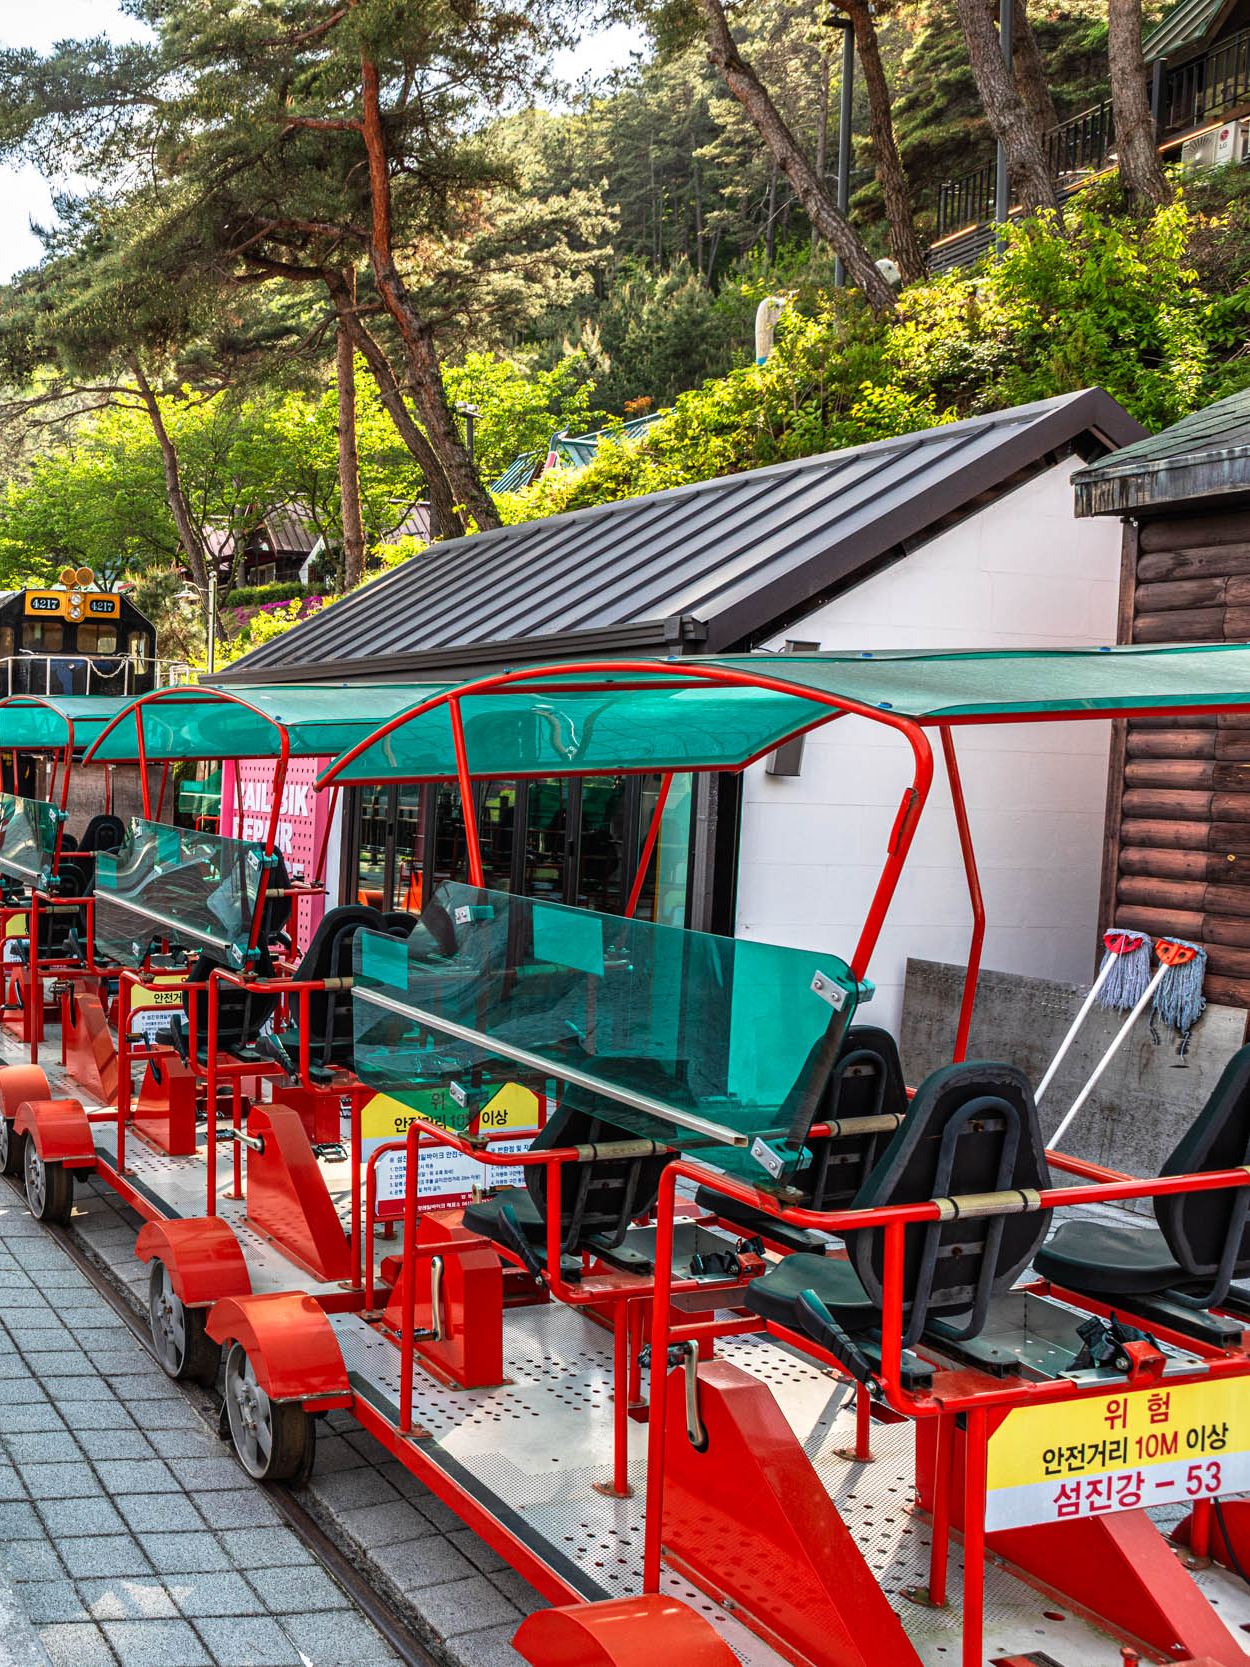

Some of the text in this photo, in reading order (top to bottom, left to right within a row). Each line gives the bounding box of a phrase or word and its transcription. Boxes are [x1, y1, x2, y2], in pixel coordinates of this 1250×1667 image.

[32, 599, 58, 610] 4217
[91, 601, 113, 612] 4217
[233, 781, 271, 813] RAIL
[154, 992, 182, 1004] 안전거
[431, 1092, 446, 1110] 위
[482, 1109, 508, 1126] 이상
[1104, 1392, 1171, 1430] 위 험
[1042, 1422, 1229, 1475] 안전거리 10M 이상
[1053, 1471, 1146, 1518] 섬진강
[1186, 1461, 1222, 1496] 53
